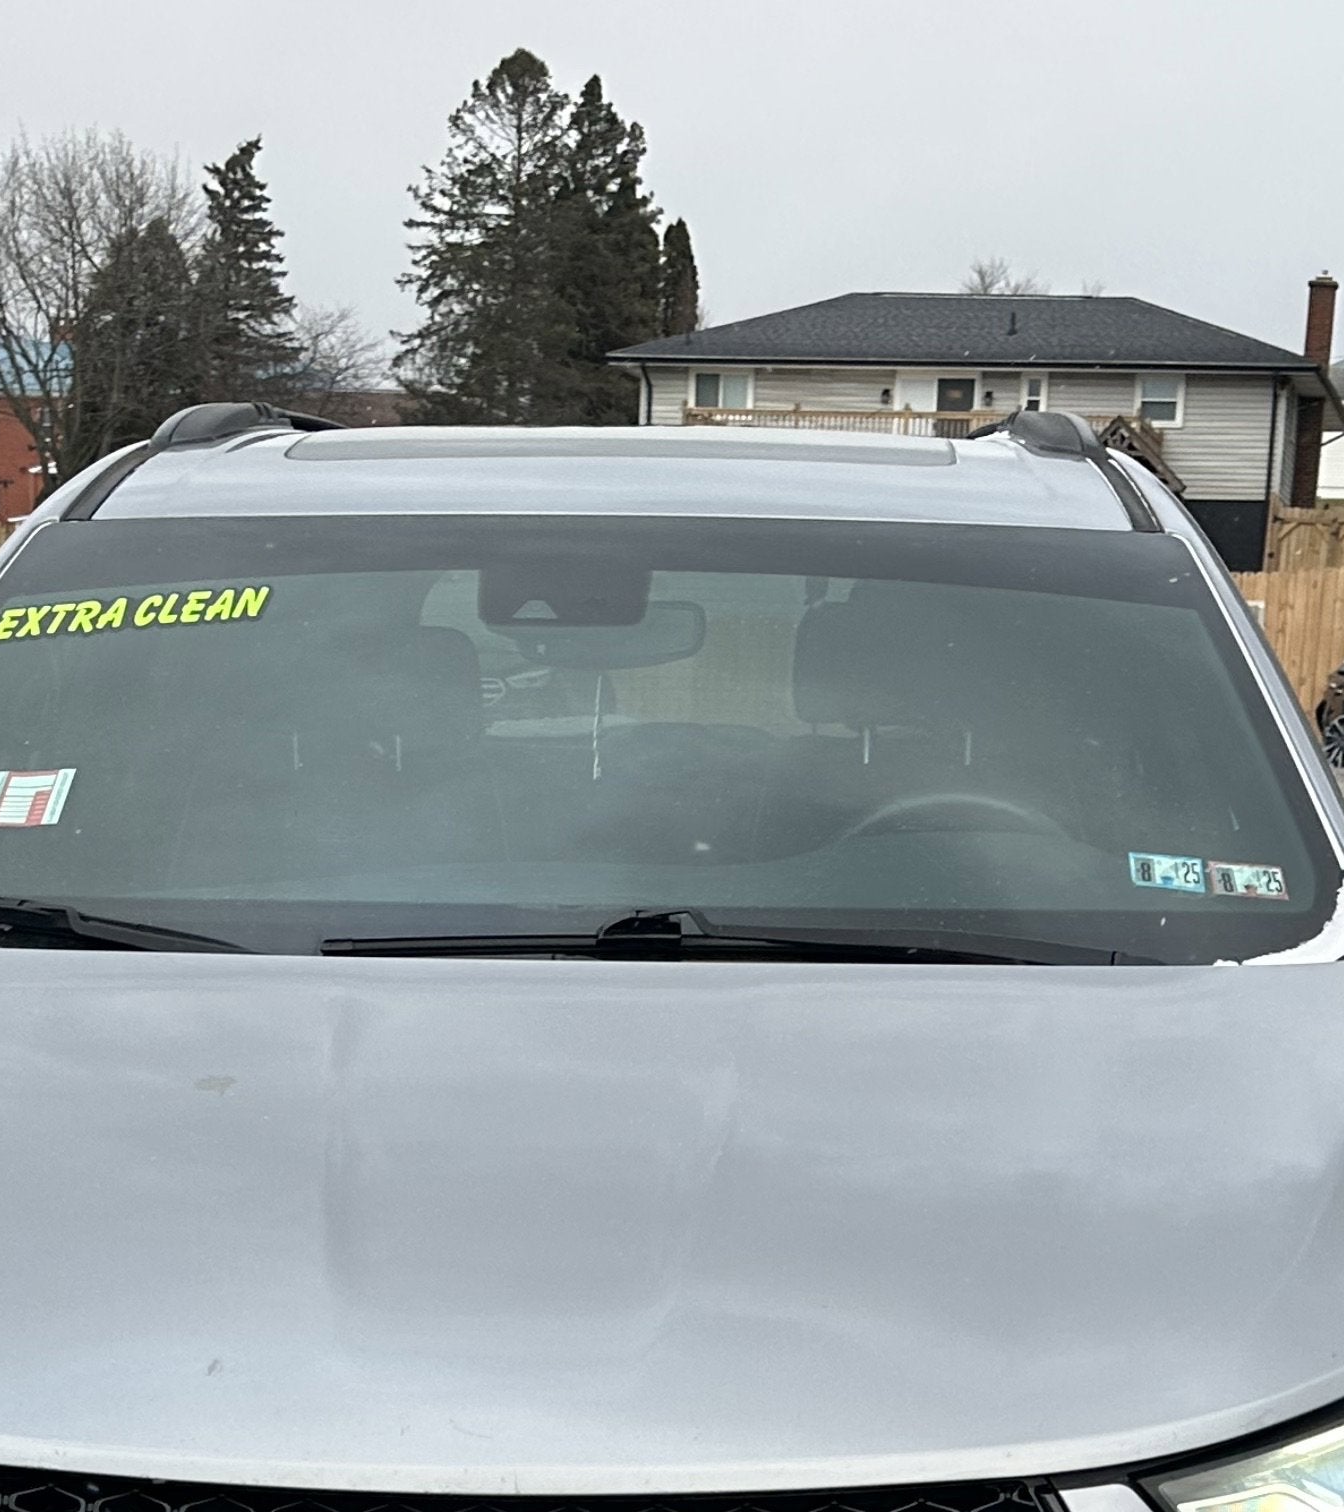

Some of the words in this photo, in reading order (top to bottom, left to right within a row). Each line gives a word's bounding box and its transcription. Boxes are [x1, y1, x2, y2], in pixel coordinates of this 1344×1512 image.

[132, 585, 271, 628] CLEAN
[1181, 861, 1201, 885] 25
[1262, 870, 1284, 894] 25
